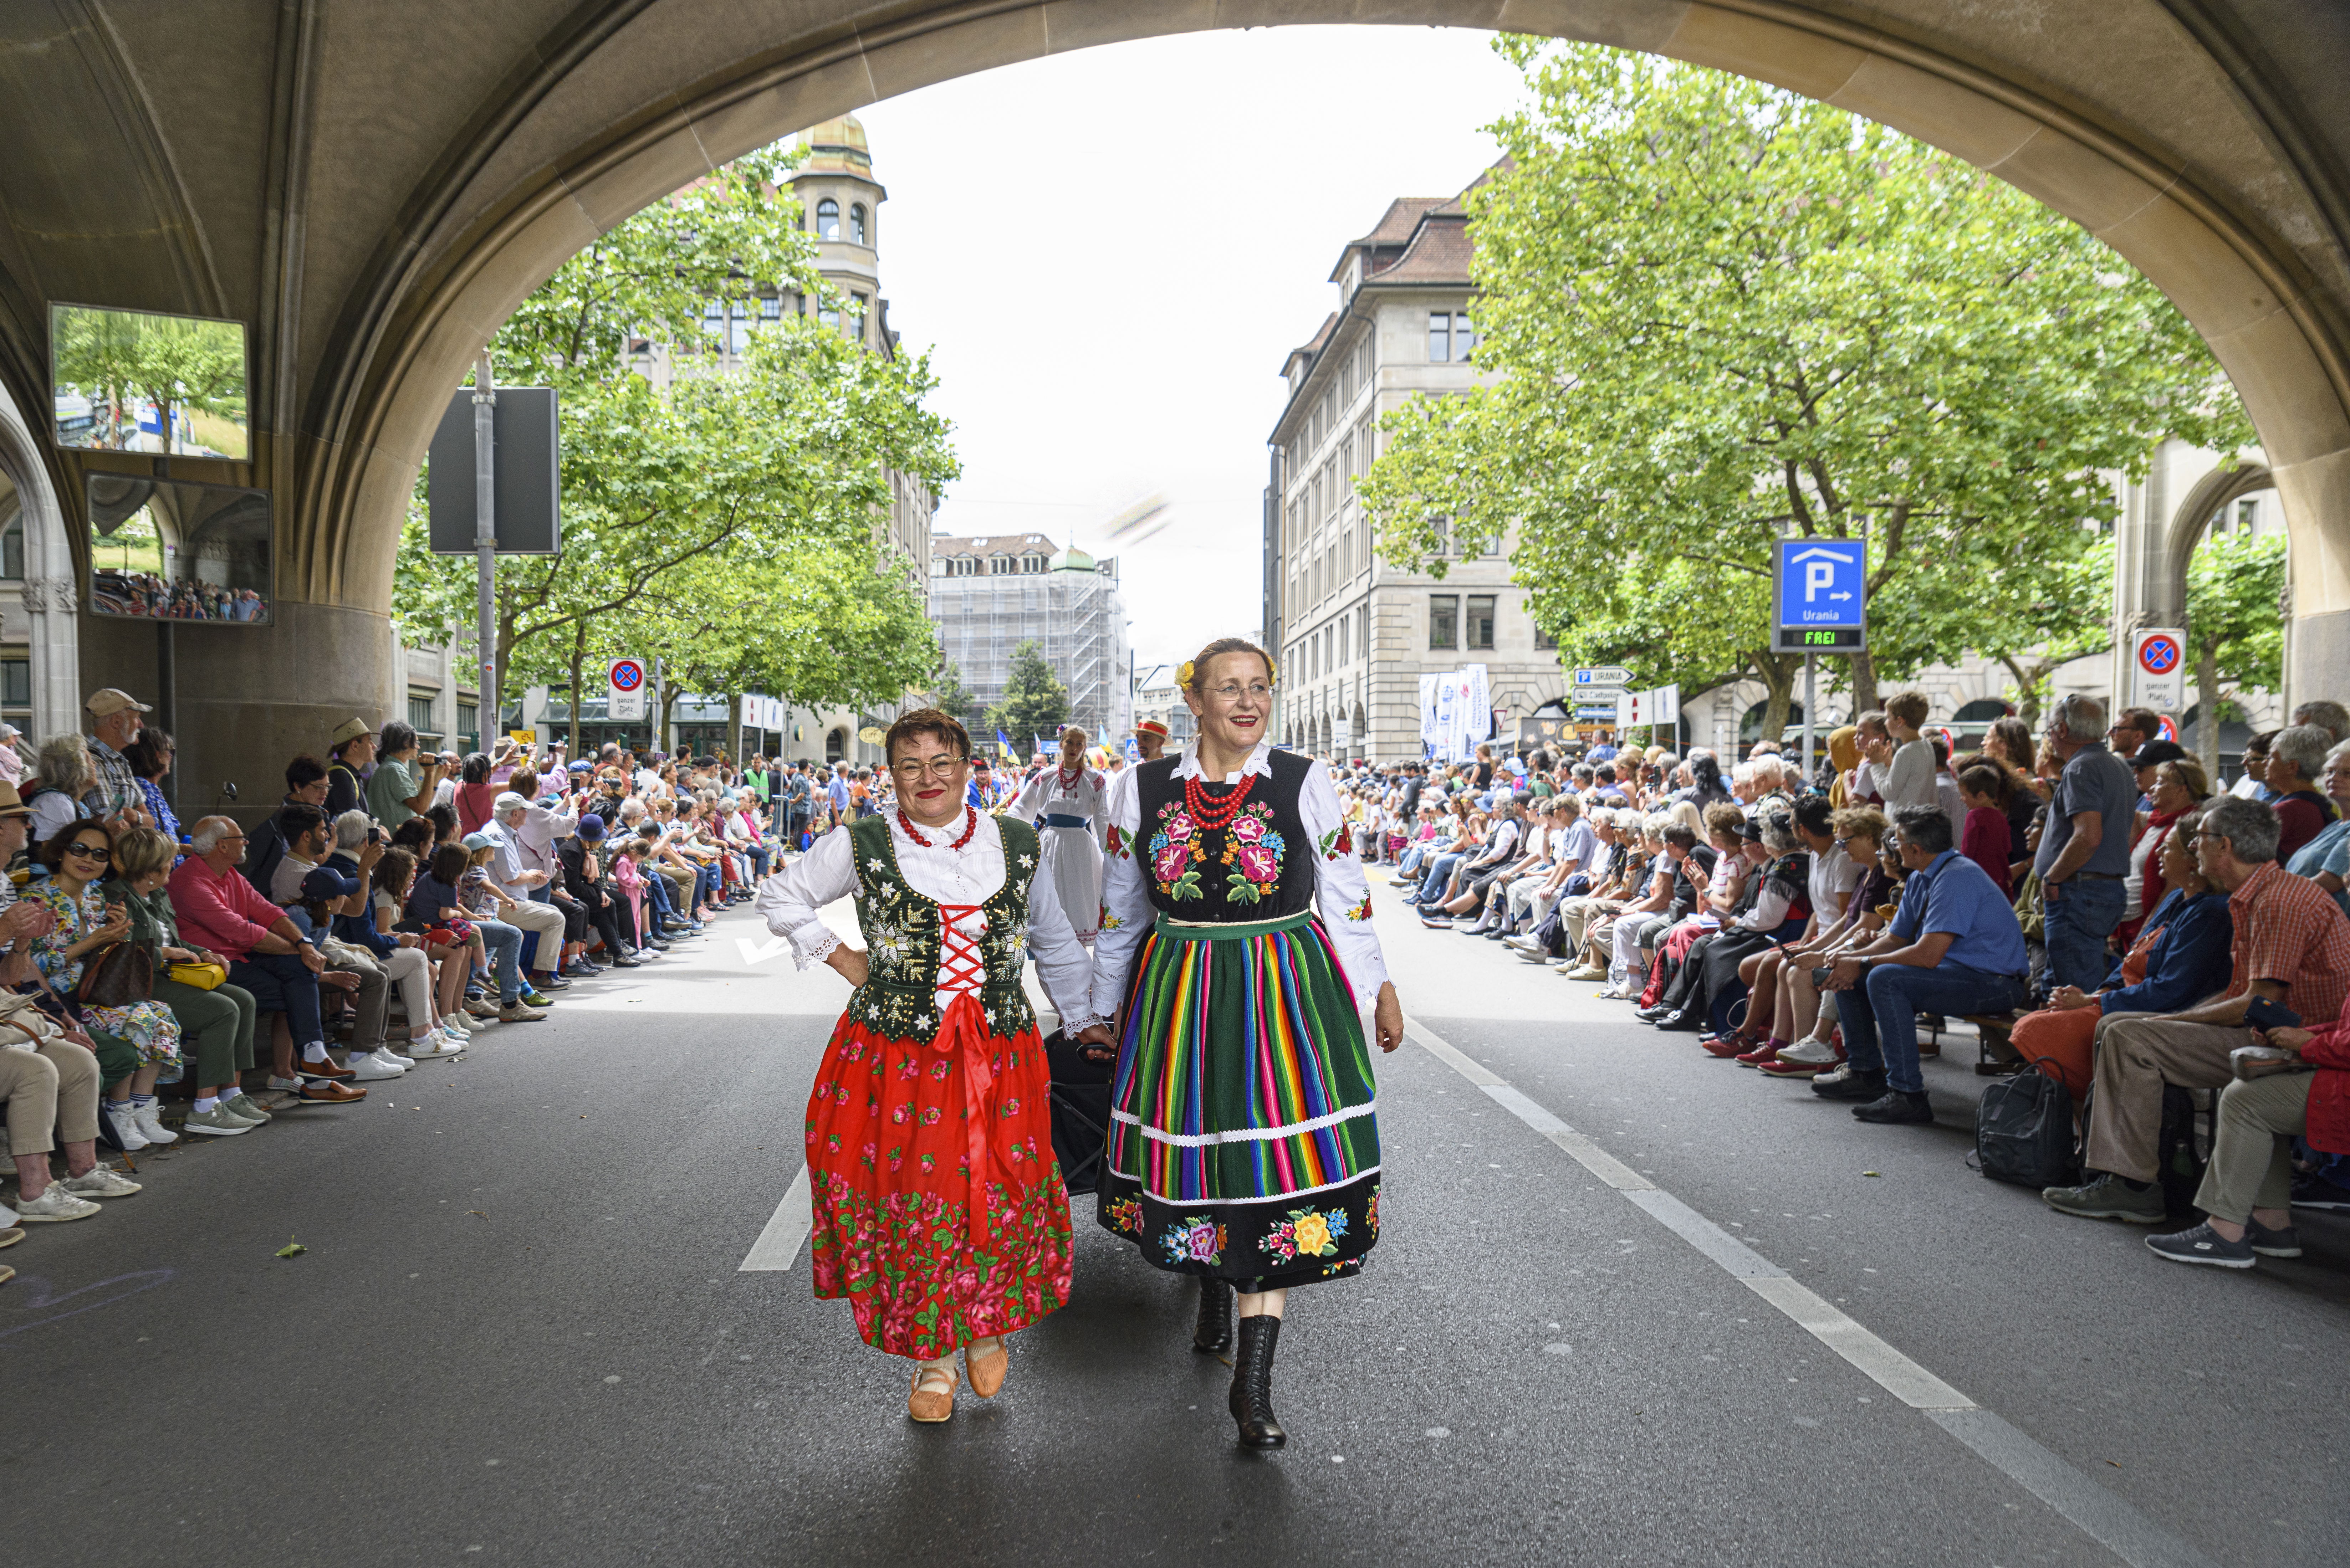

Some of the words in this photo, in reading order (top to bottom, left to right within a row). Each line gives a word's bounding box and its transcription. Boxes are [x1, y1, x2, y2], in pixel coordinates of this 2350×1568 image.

[1805, 562, 1834, 602] P
[1803, 609, 1839, 621] Urania
[1805, 631, 1835, 644] FREI
